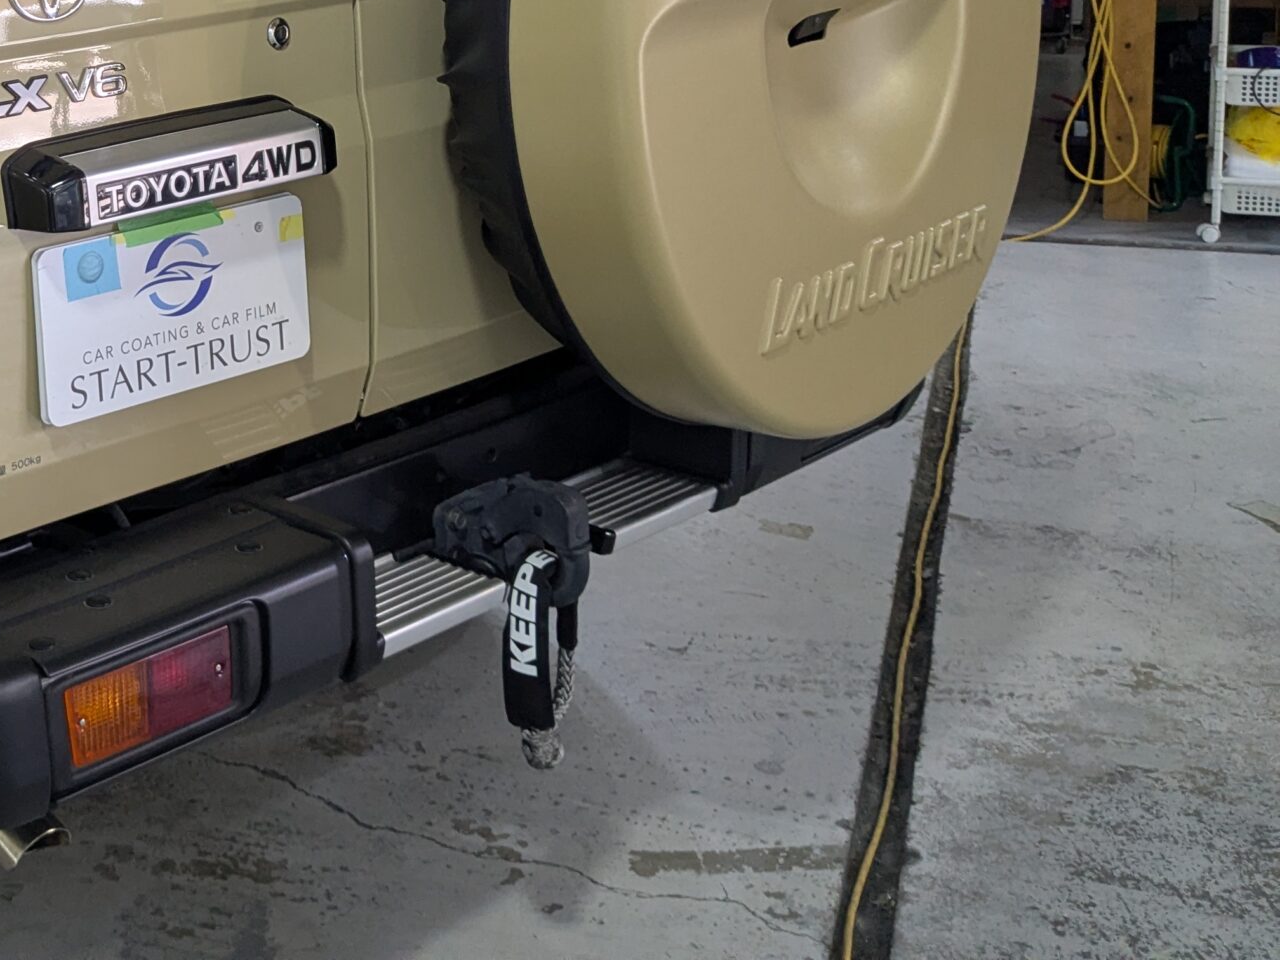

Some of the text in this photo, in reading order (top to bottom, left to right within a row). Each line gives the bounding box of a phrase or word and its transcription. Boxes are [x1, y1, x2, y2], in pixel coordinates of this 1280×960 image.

[57, 62, 128, 104] V6
[103, 138, 318, 214] TOYOTA 4WD
[70, 318, 290, 410] START-TRUST
[82, 301, 279, 366] CAR COATING & CAR FILM
[11, 455, 42, 471] 500kg
[509, 548, 559, 678] KEEPE
